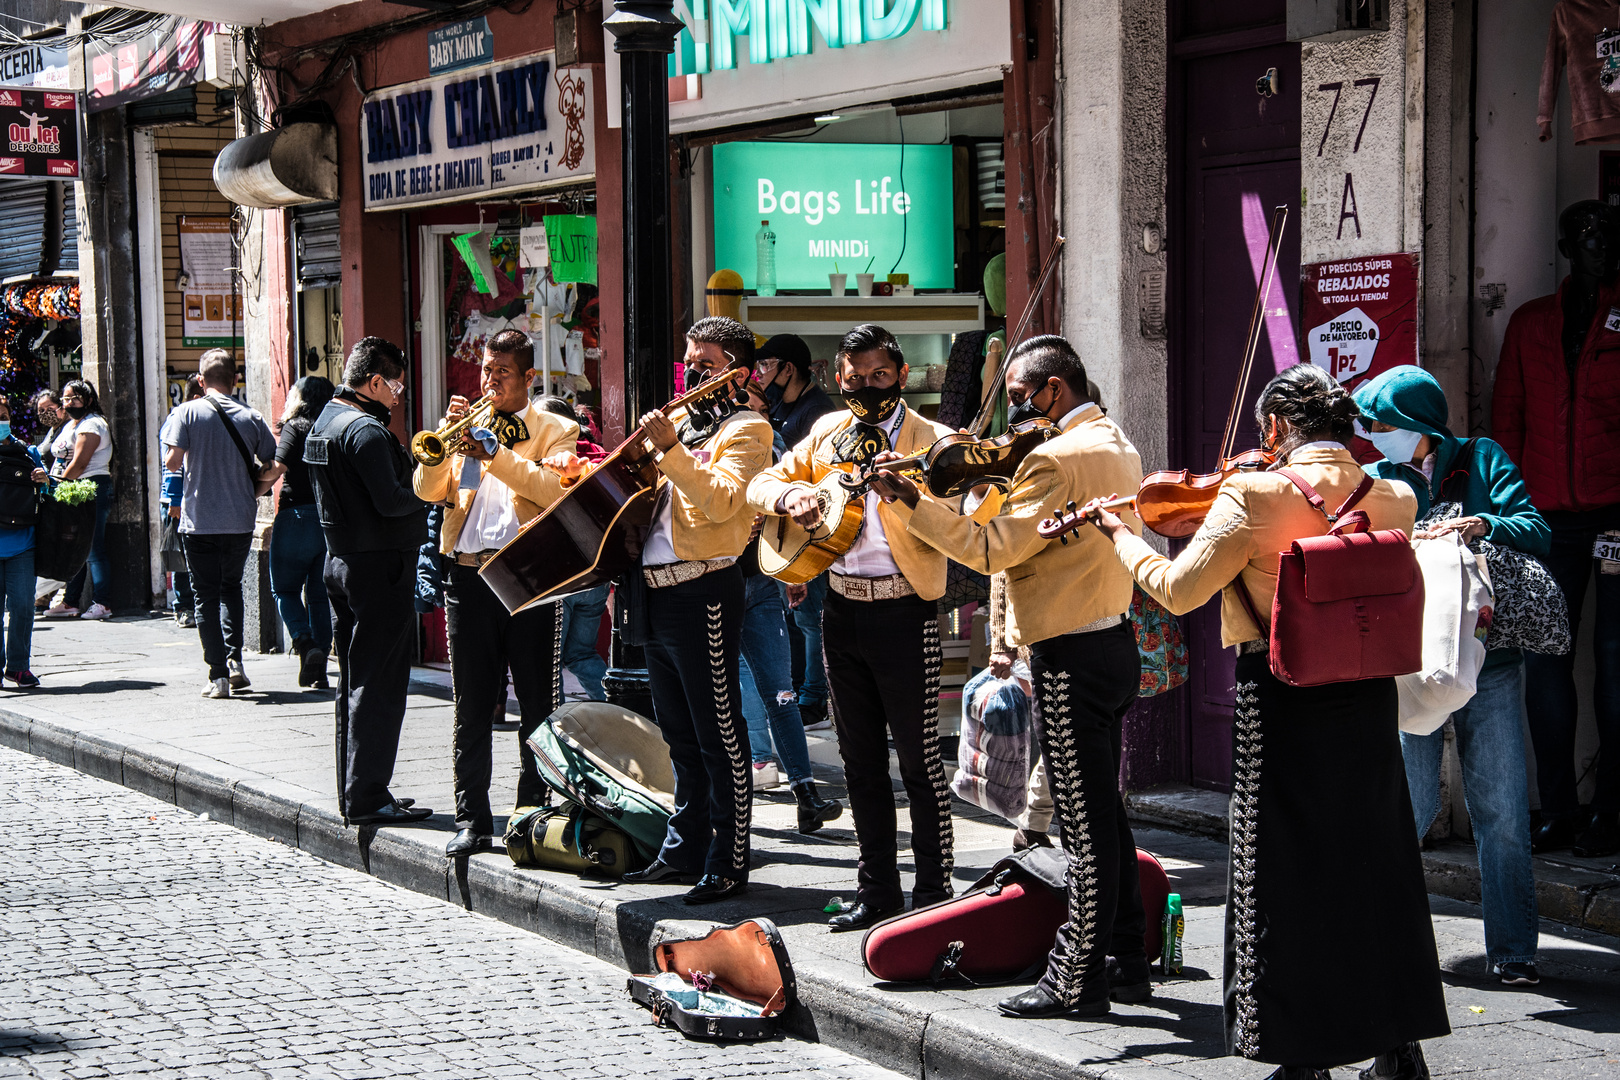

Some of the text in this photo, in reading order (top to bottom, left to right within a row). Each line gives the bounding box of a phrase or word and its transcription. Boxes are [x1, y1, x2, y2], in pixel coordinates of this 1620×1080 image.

[435, 20, 474, 40] THE WORLD OF
[430, 30, 485, 69] BABY MINK
[364, 60, 550, 163] BABY CHARLY
[1317, 77, 1381, 157] 77
[9, 142, 60, 154] DEPORTES
[487, 149, 511, 166] ORREO
[513, 144, 534, 162] MAYOR
[369, 156, 485, 202] ROPA DE BEBE E INFANTIL
[757, 176, 911, 225] Bags Life
[1336, 172, 1362, 240] A
[808, 239, 869, 258] MINIDi
[1328, 261, 1364, 275] PRECIOS
[1364, 257, 1393, 271] SÚPER
[1317, 273, 1391, 293] REBAJADOS
[1322, 291, 1389, 305] EN TODA LA TIENDA!
[1320, 331, 1368, 342] DE MAYOREO
[1329, 320, 1363, 333] PRECIO
[845, 581, 867, 589] CIELITO
[847, 589, 865, 597] LINDO
